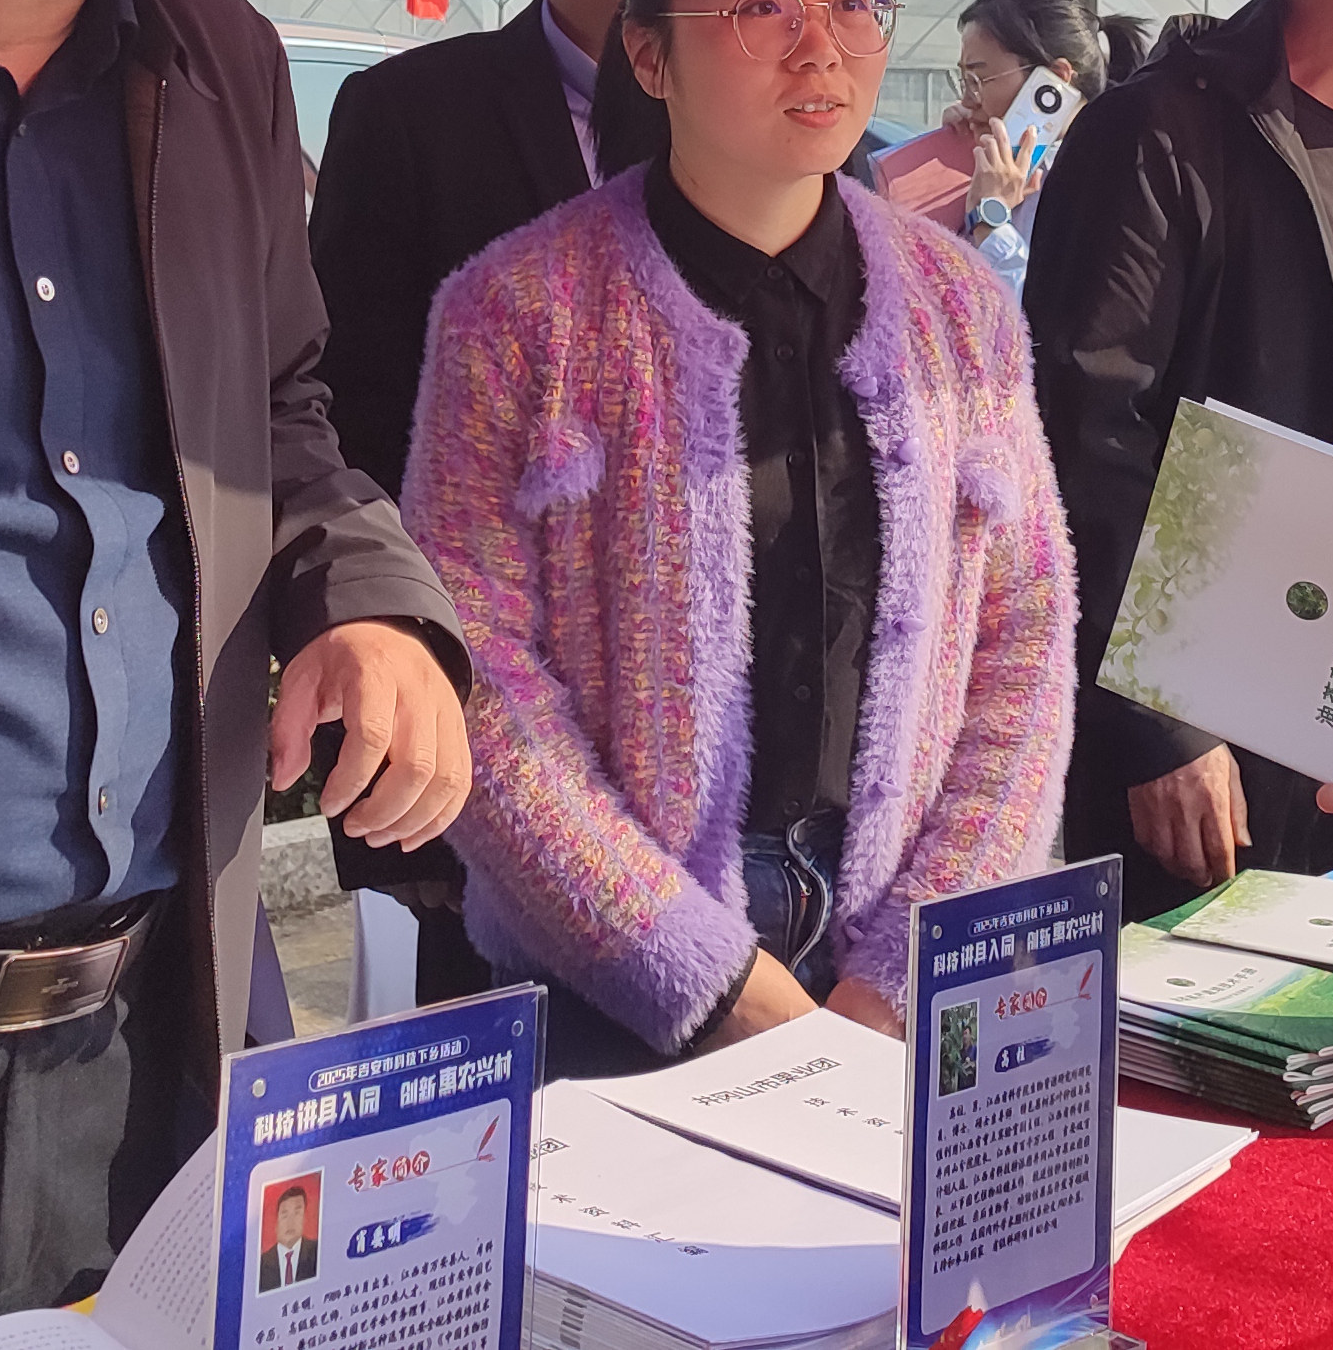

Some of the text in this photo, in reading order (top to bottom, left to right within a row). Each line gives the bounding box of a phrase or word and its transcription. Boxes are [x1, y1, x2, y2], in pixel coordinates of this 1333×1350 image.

[1027, 910, 1104, 953] 创新惠农兴村
[399, 1050, 513, 1109] 创新惠农兴村
[691, 1057, 842, 1106] 井冈山市果业团
[347, 1150, 432, 1193] 专家简介
